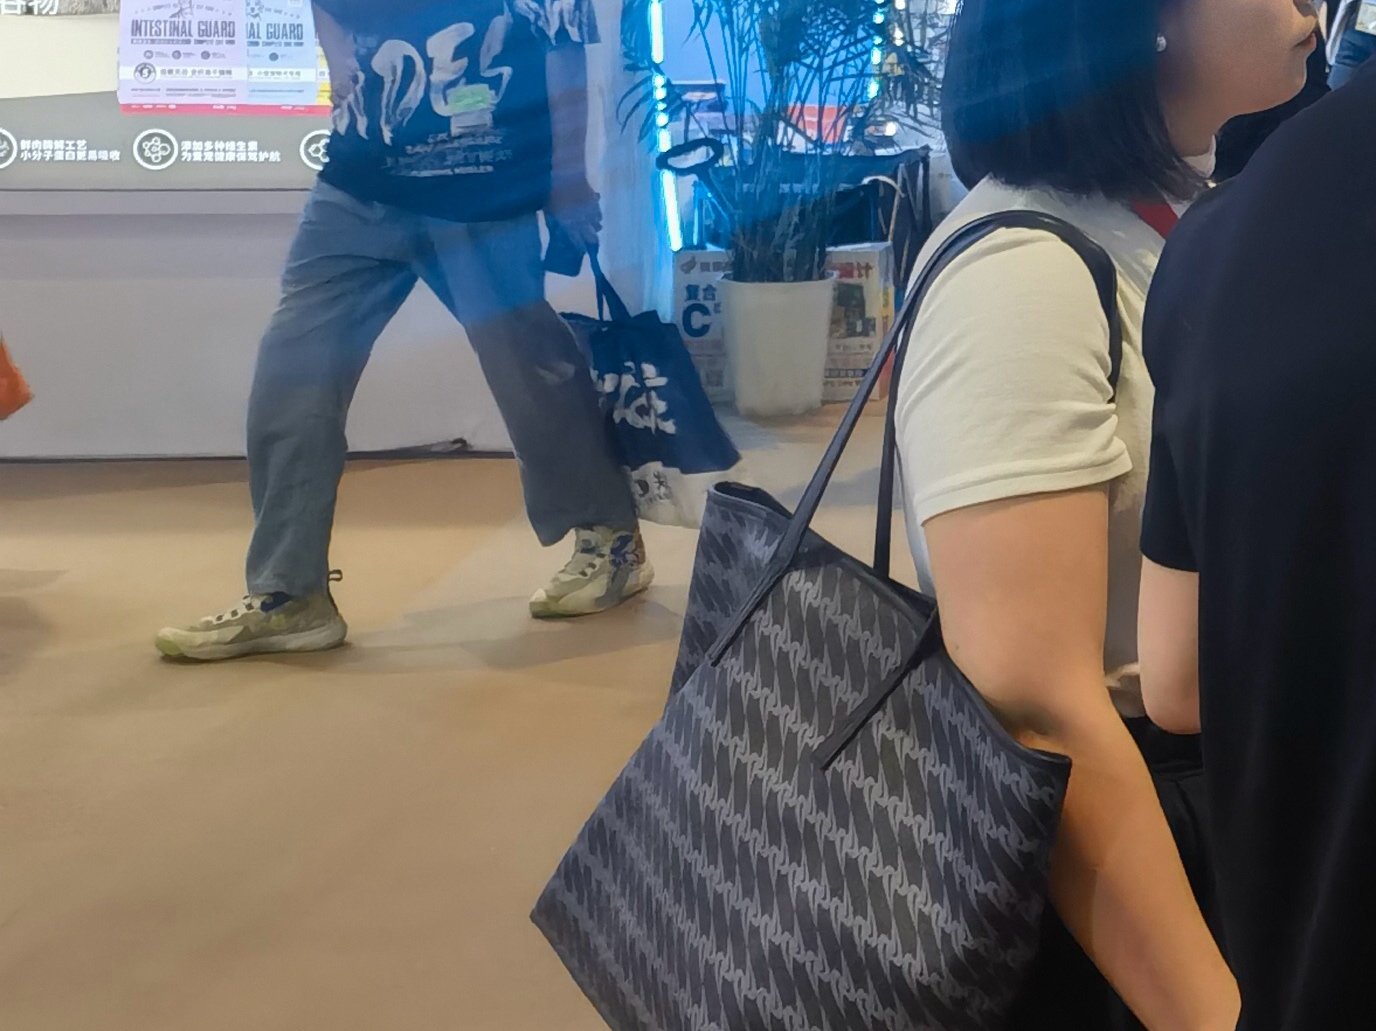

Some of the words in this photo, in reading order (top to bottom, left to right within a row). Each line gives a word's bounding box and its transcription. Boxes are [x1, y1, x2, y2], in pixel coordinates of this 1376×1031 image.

[131, 19, 193, 38] INTESTINAL
[197, 20, 236, 38] GUARD
[266, 23, 304, 41] GUARD
